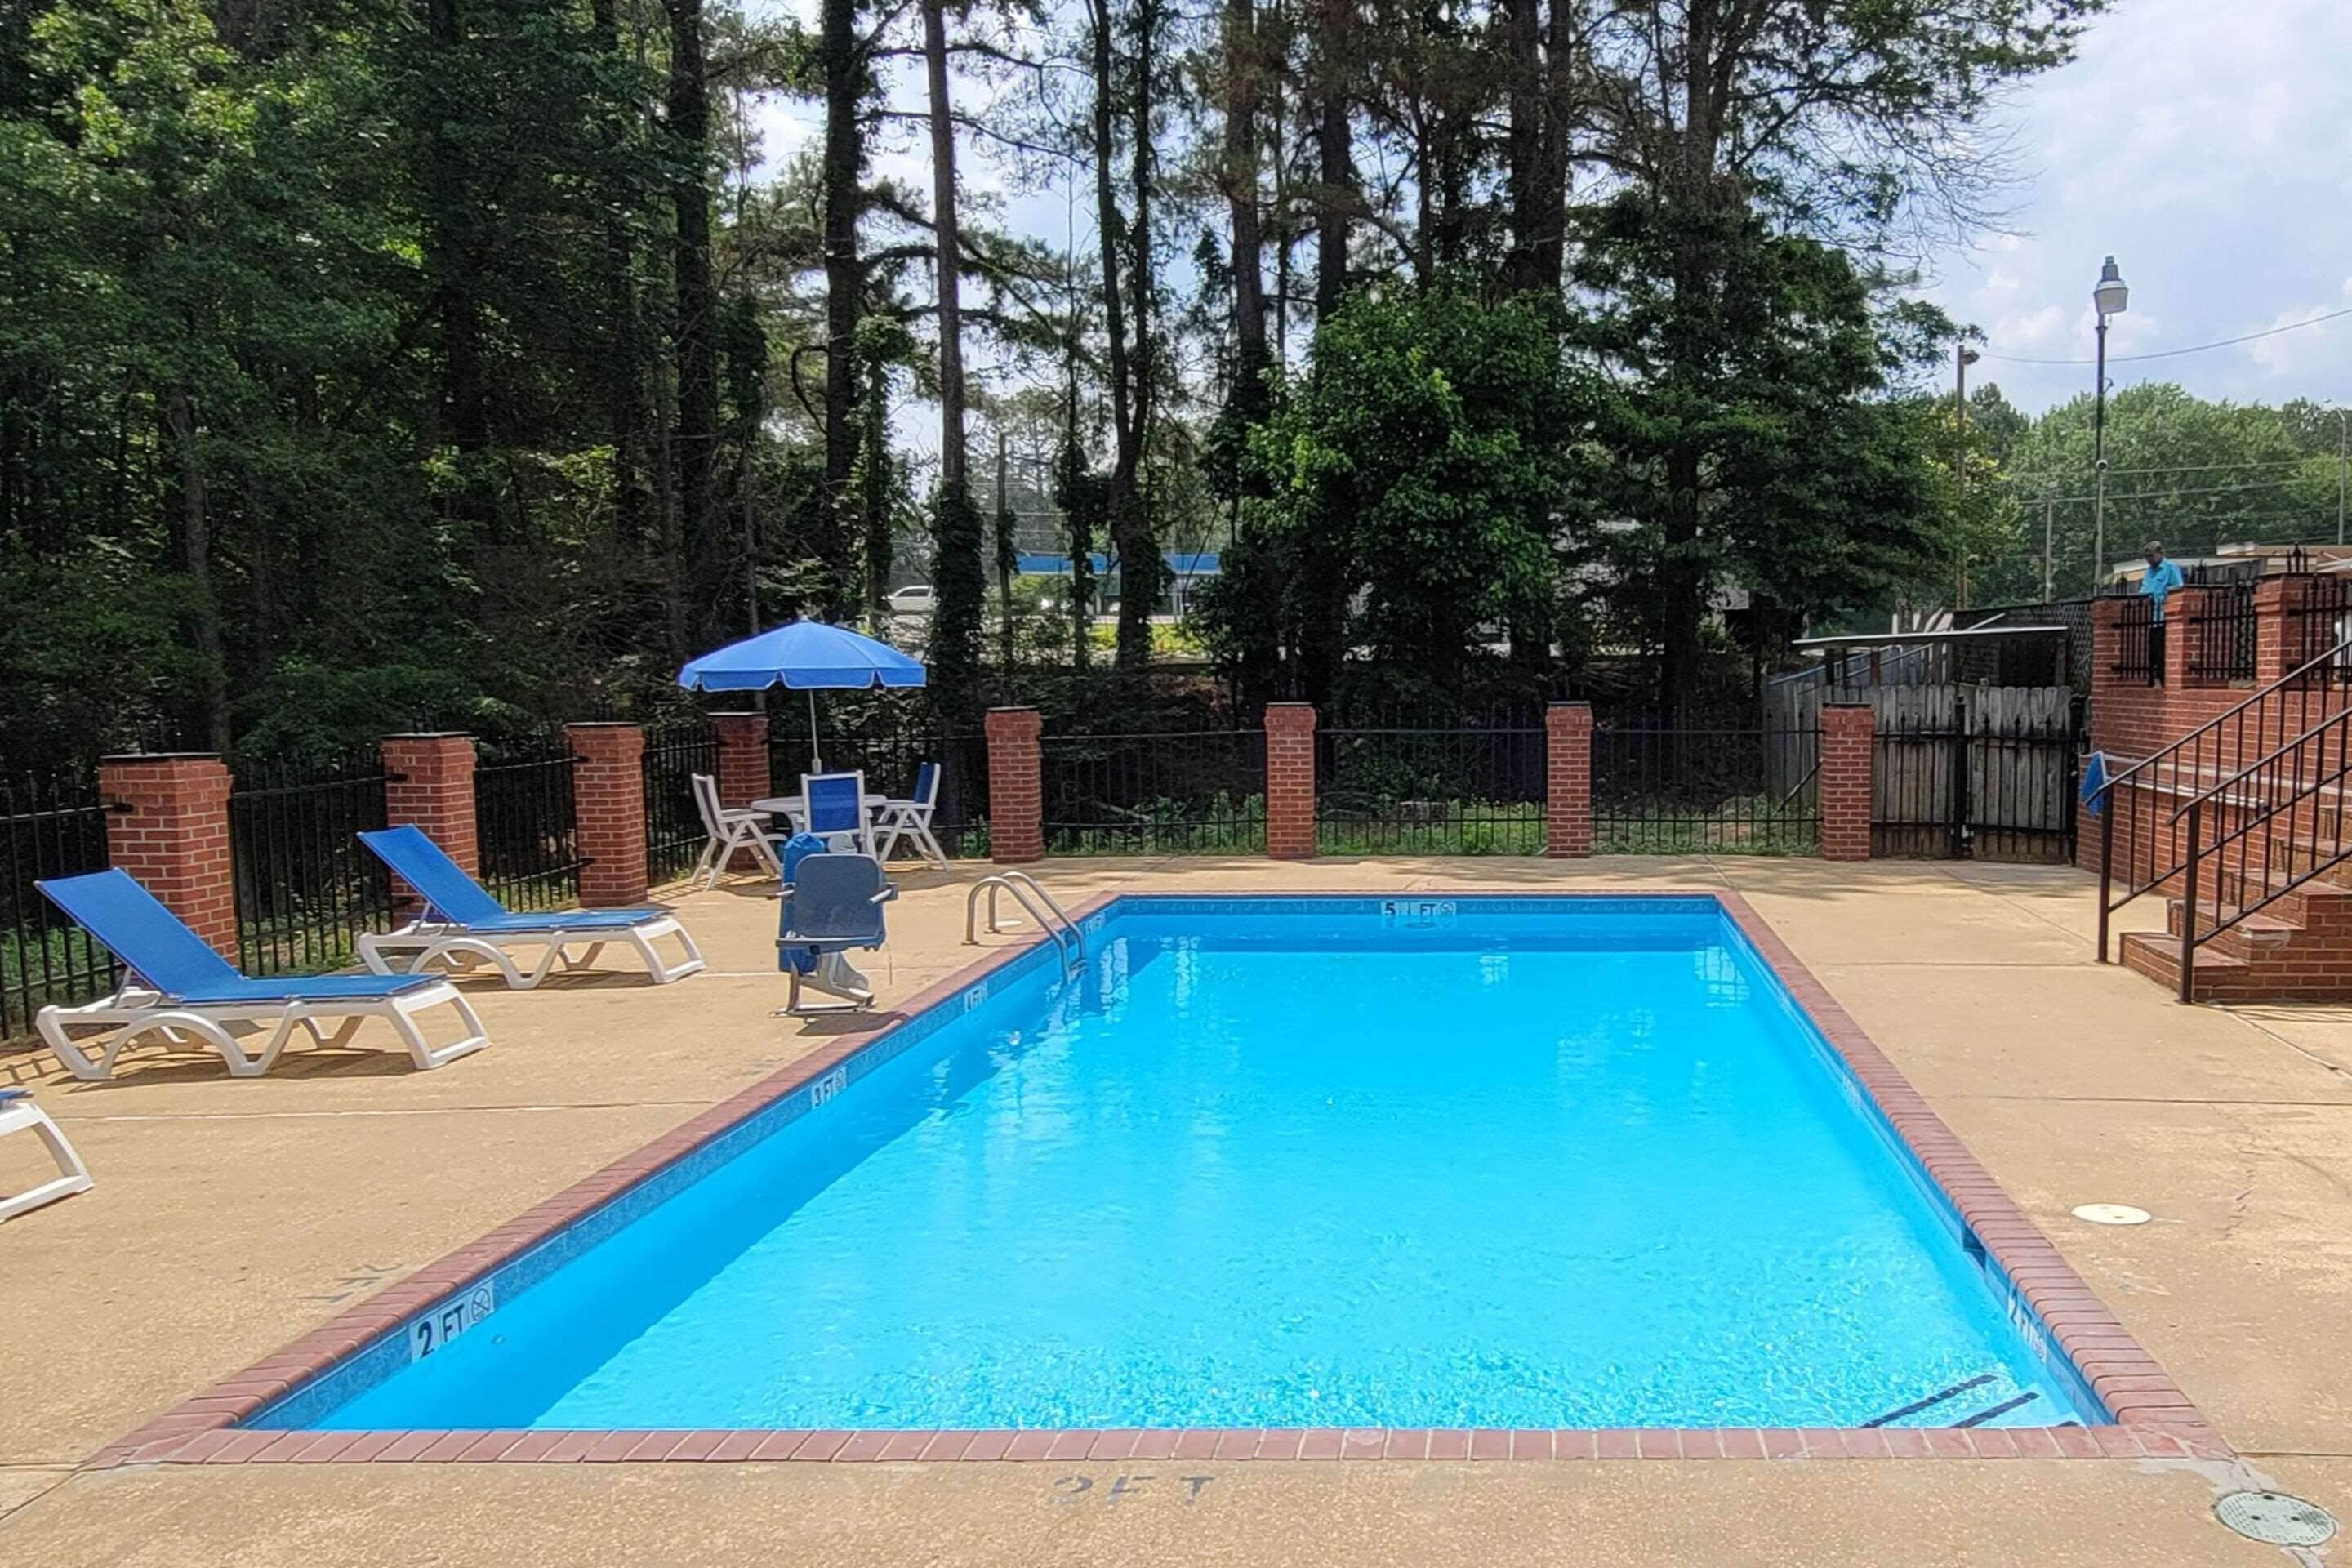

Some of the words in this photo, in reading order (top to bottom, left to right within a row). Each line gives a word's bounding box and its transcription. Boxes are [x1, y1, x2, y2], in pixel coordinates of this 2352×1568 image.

[1384, 902, 1396, 916] 5
[1419, 903, 1437, 915] FT
[418, 1321, 434, 1360] 2
[442, 1303, 465, 1343] FT
